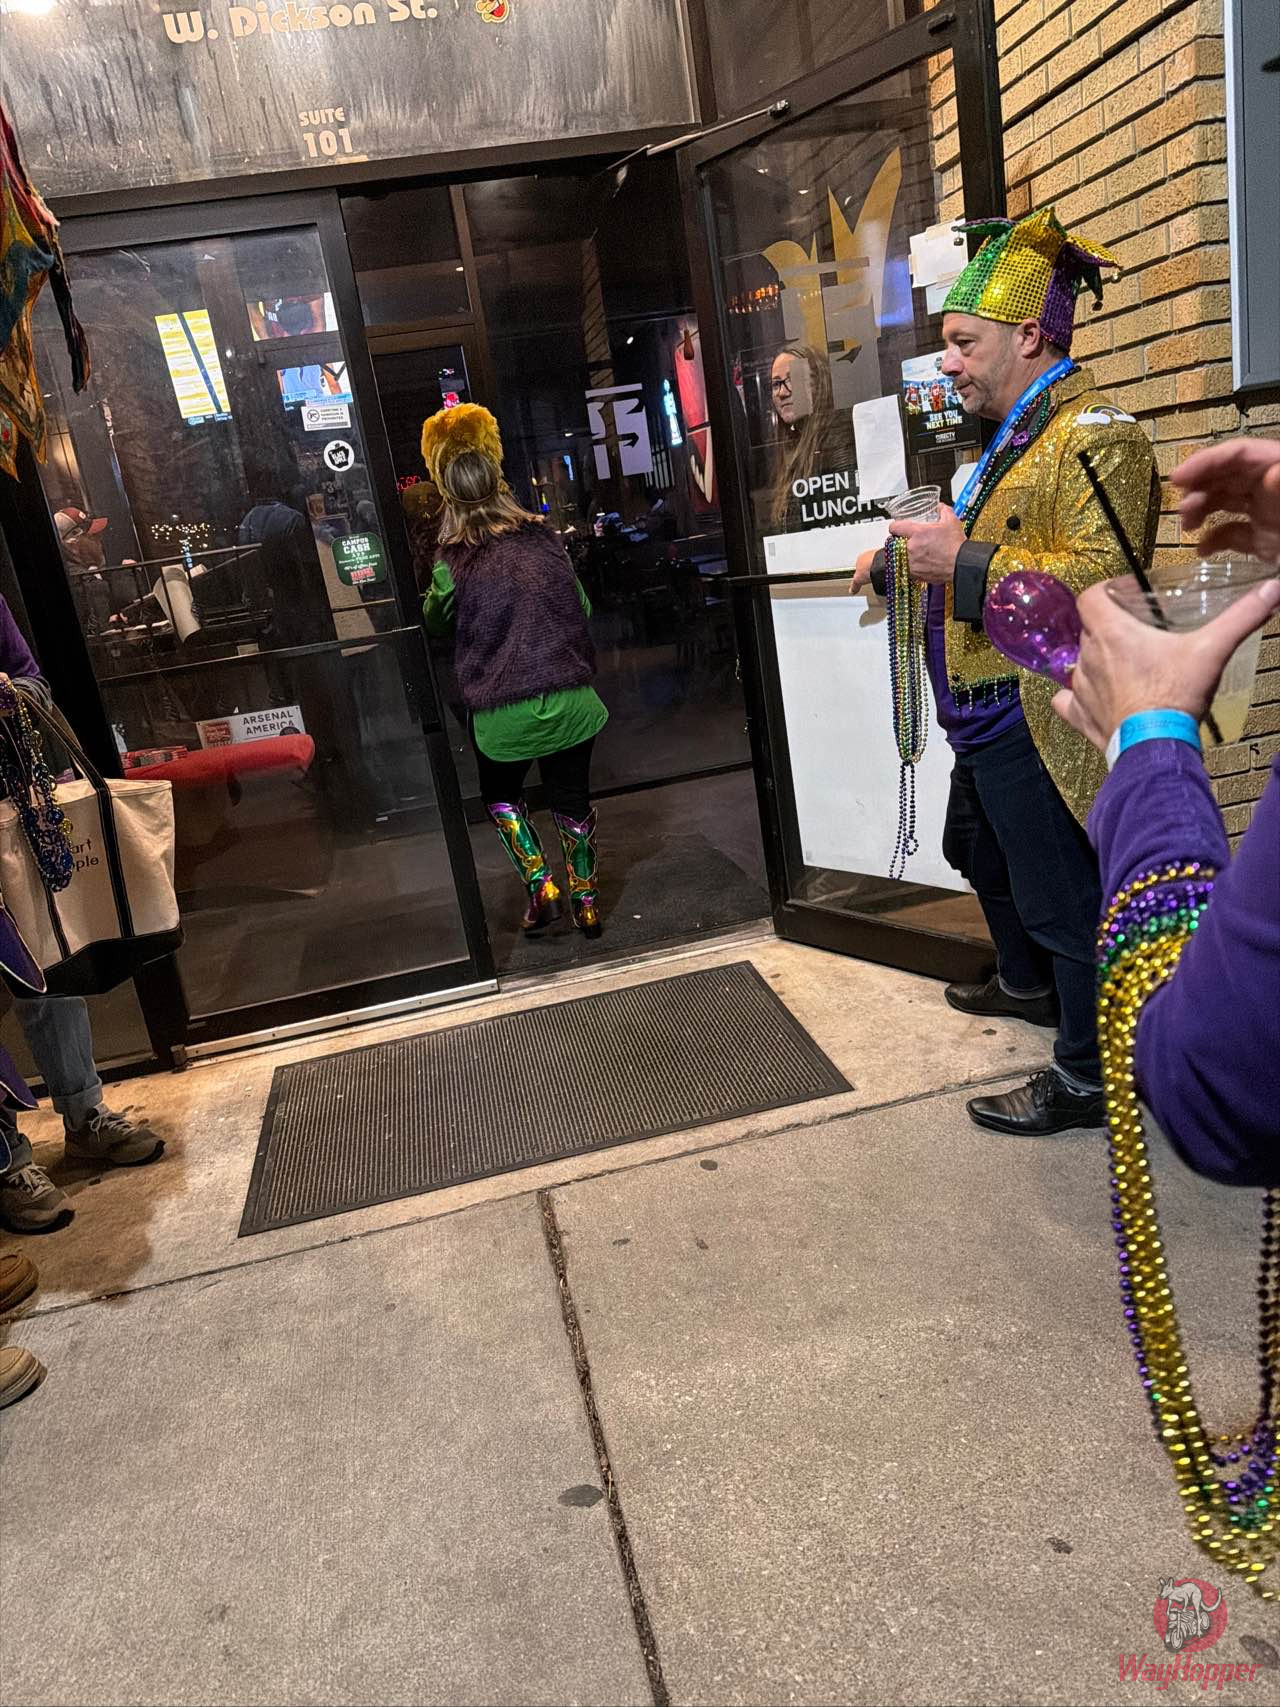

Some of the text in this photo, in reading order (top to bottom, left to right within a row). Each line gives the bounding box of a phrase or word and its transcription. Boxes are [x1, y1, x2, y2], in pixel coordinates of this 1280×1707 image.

[162, 0, 438, 44] W. Dickson St.
[299, 106, 346, 127] SUITE
[303, 127, 354, 158] 101
[926, 415, 963, 430] NEXT TIME
[929, 409, 959, 422] SEE YOU
[792, 471, 850, 498] OPEN
[802, 494, 872, 523] LUNCH
[341, 537, 369, 547] CAMPUS
[343, 543, 371, 554] CASH
[243, 709, 294, 726] ARSENAL
[246, 719, 295, 735] AMERICA
